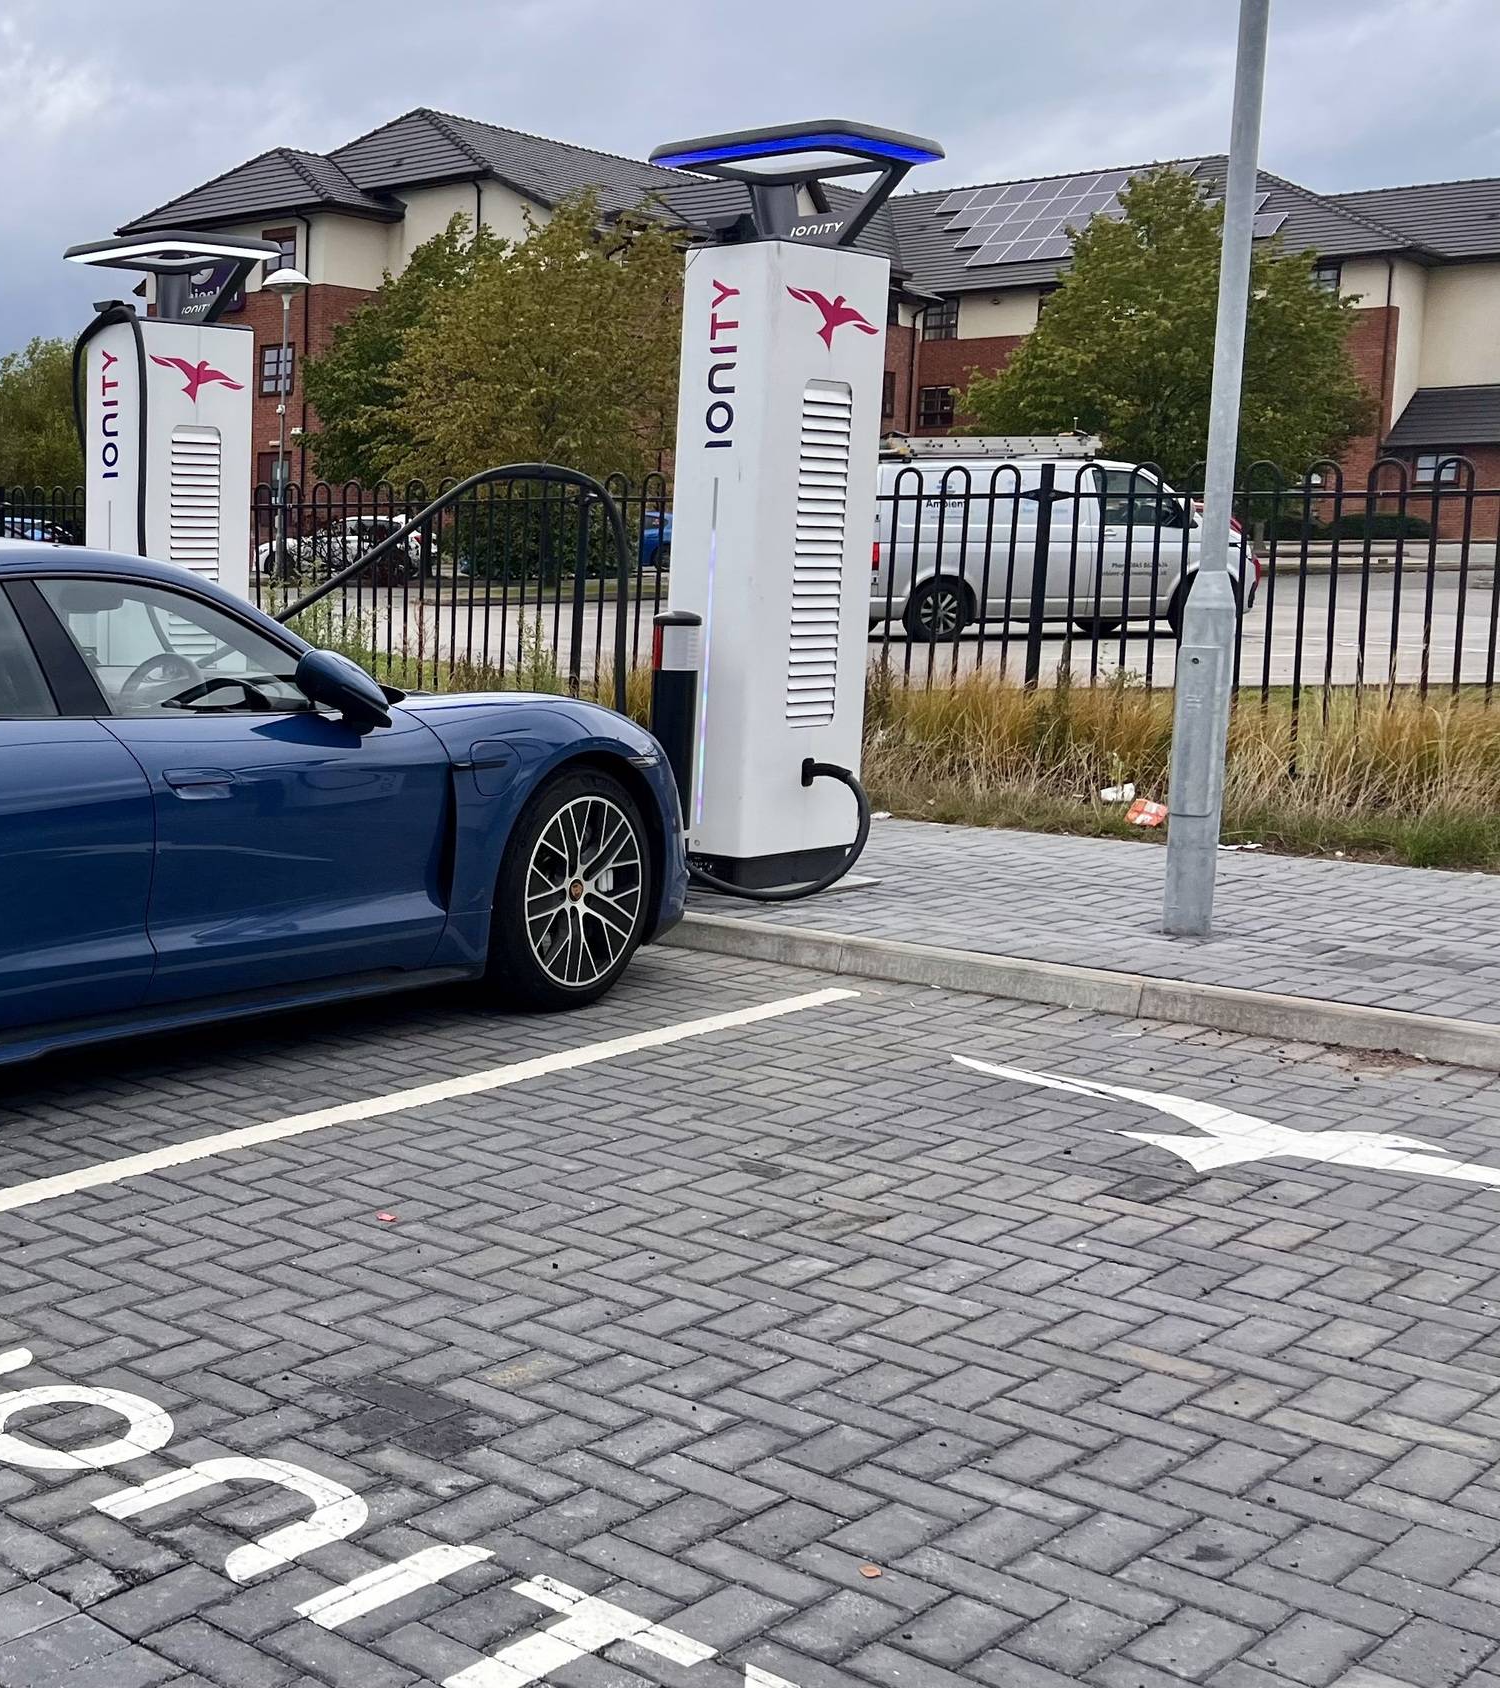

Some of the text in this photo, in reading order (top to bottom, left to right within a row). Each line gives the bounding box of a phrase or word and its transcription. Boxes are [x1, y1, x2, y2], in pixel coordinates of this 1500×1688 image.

[790, 221, 844, 237] IONITY
[181, 303, 211, 314] IONIT
[704, 279, 741, 449] IONITY
[102, 350, 118, 479] IONITY
